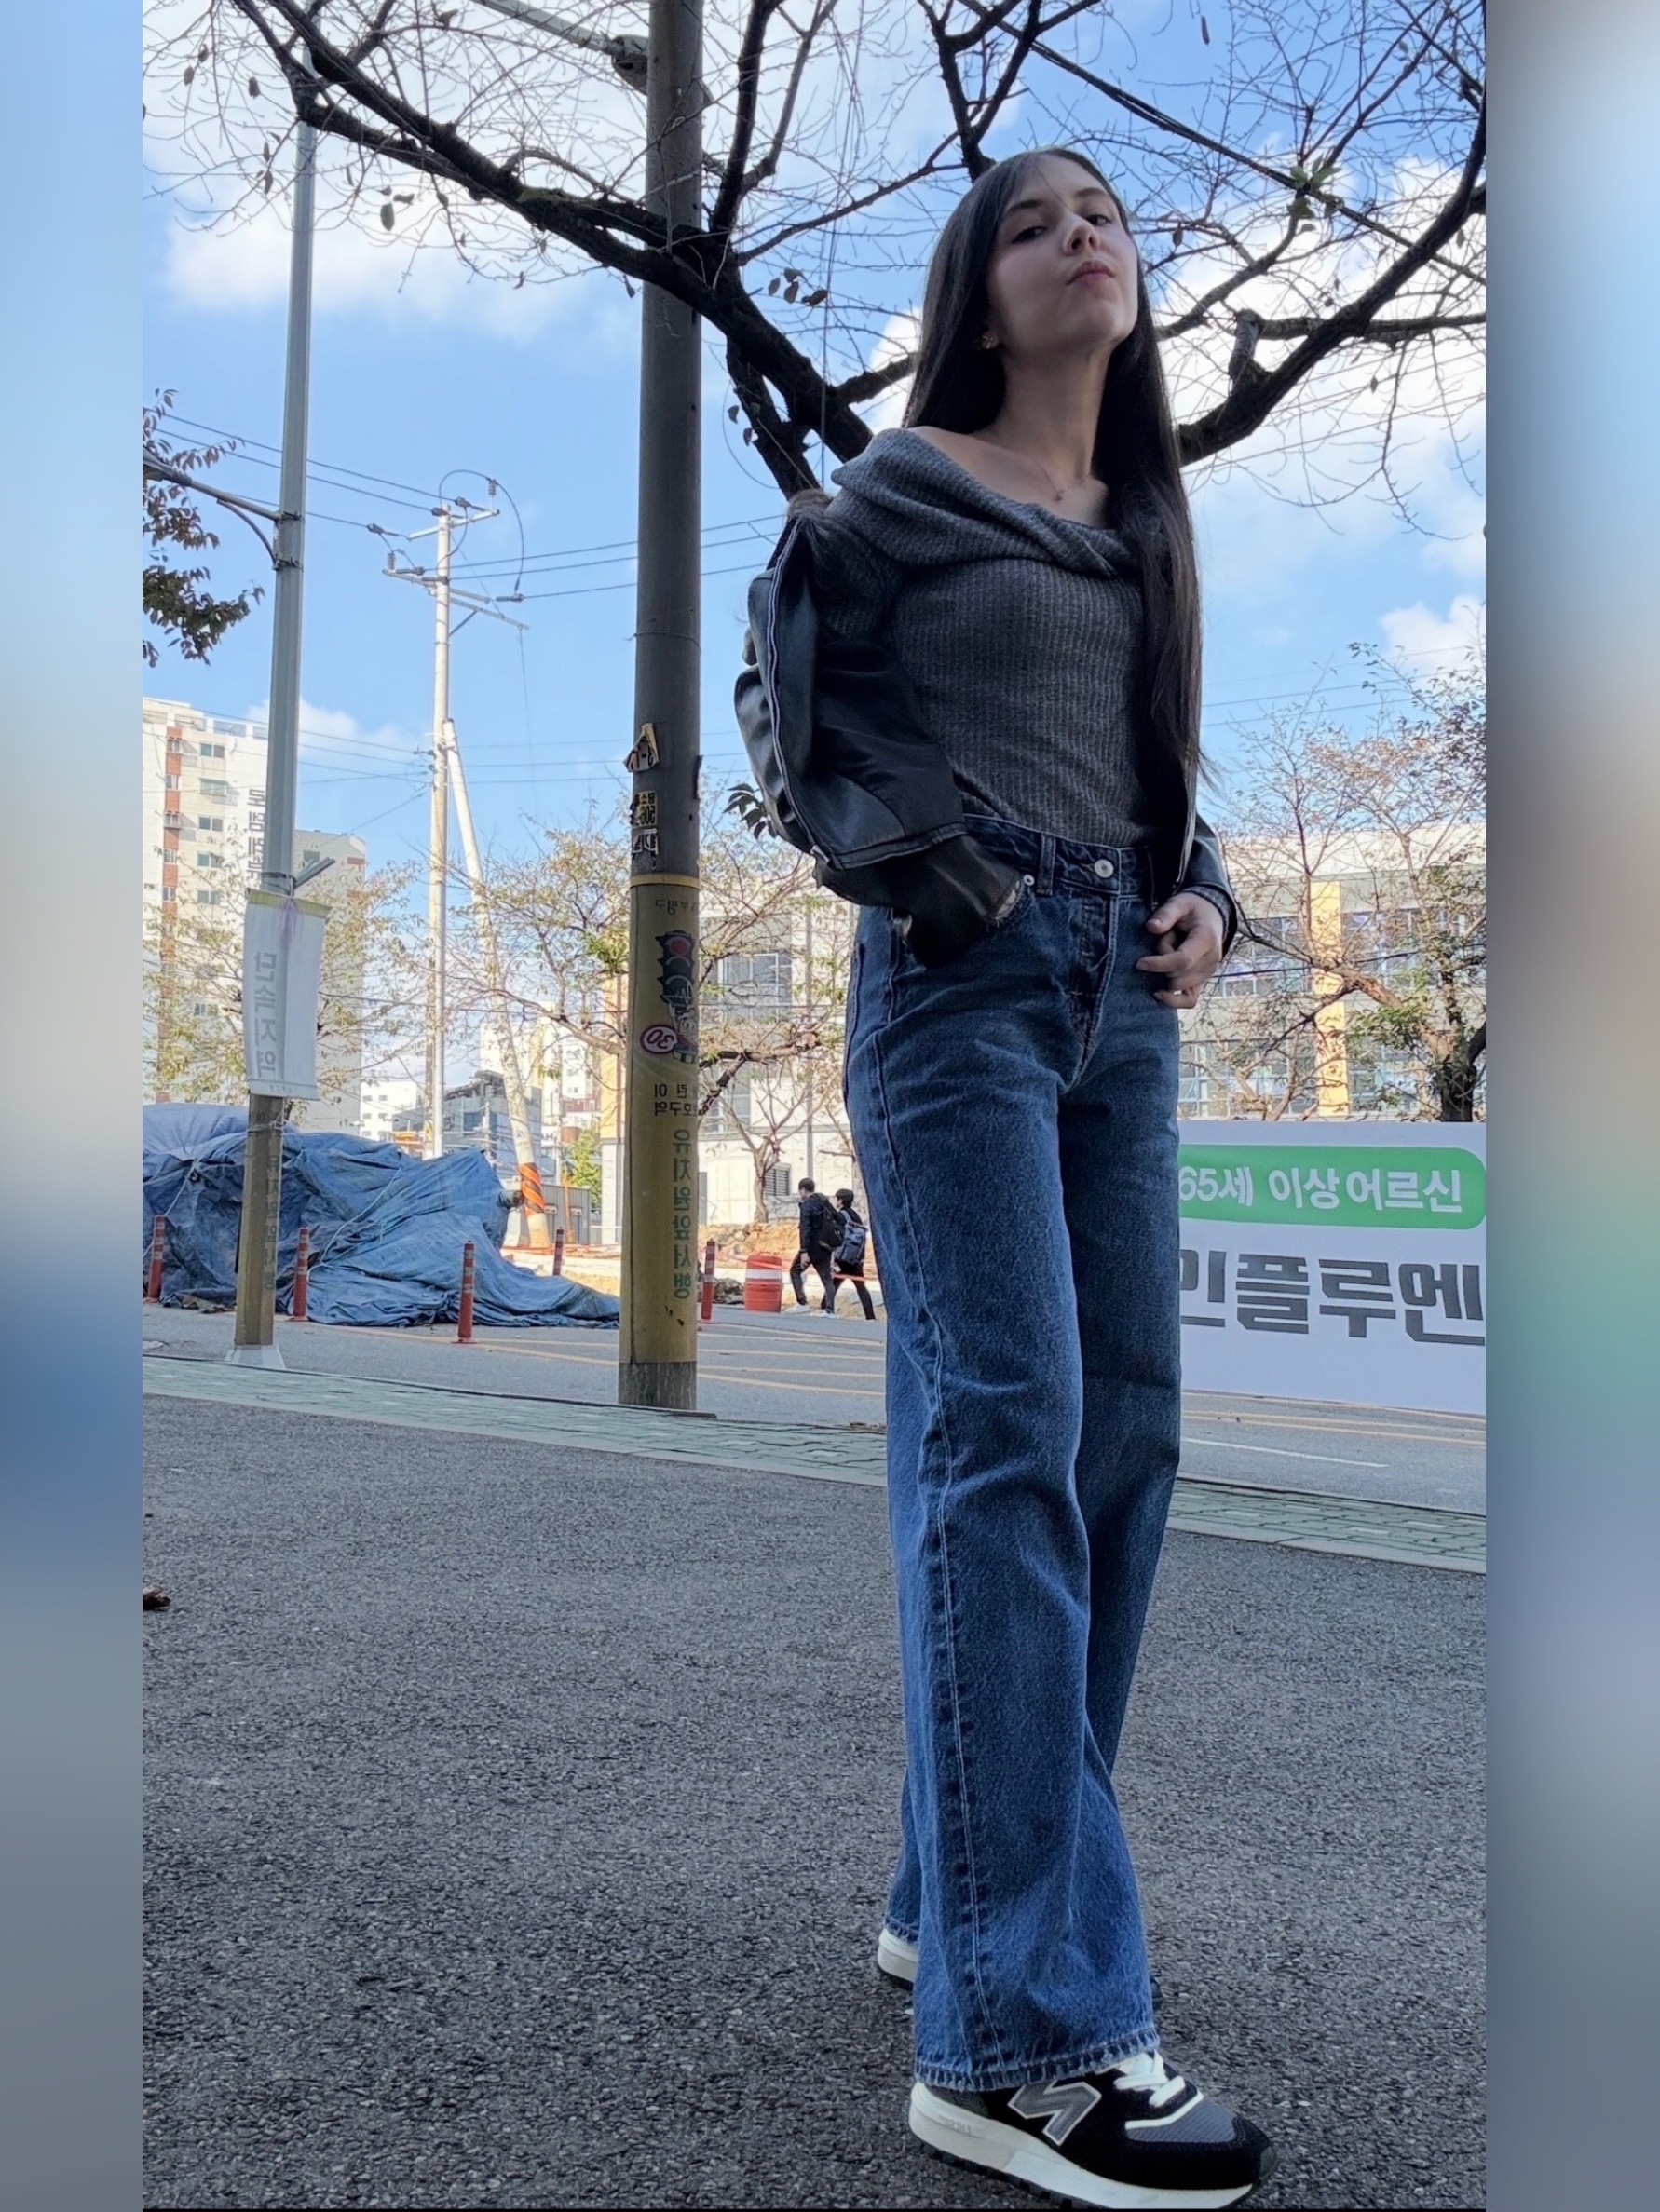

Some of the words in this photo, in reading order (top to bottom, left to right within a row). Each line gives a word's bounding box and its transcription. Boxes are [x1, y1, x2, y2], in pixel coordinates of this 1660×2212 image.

[1178, 1165, 1254, 1207] 65세
[1268, 1167, 1340, 1210] 이상
[1345, 1168, 1463, 1213] 어르신
